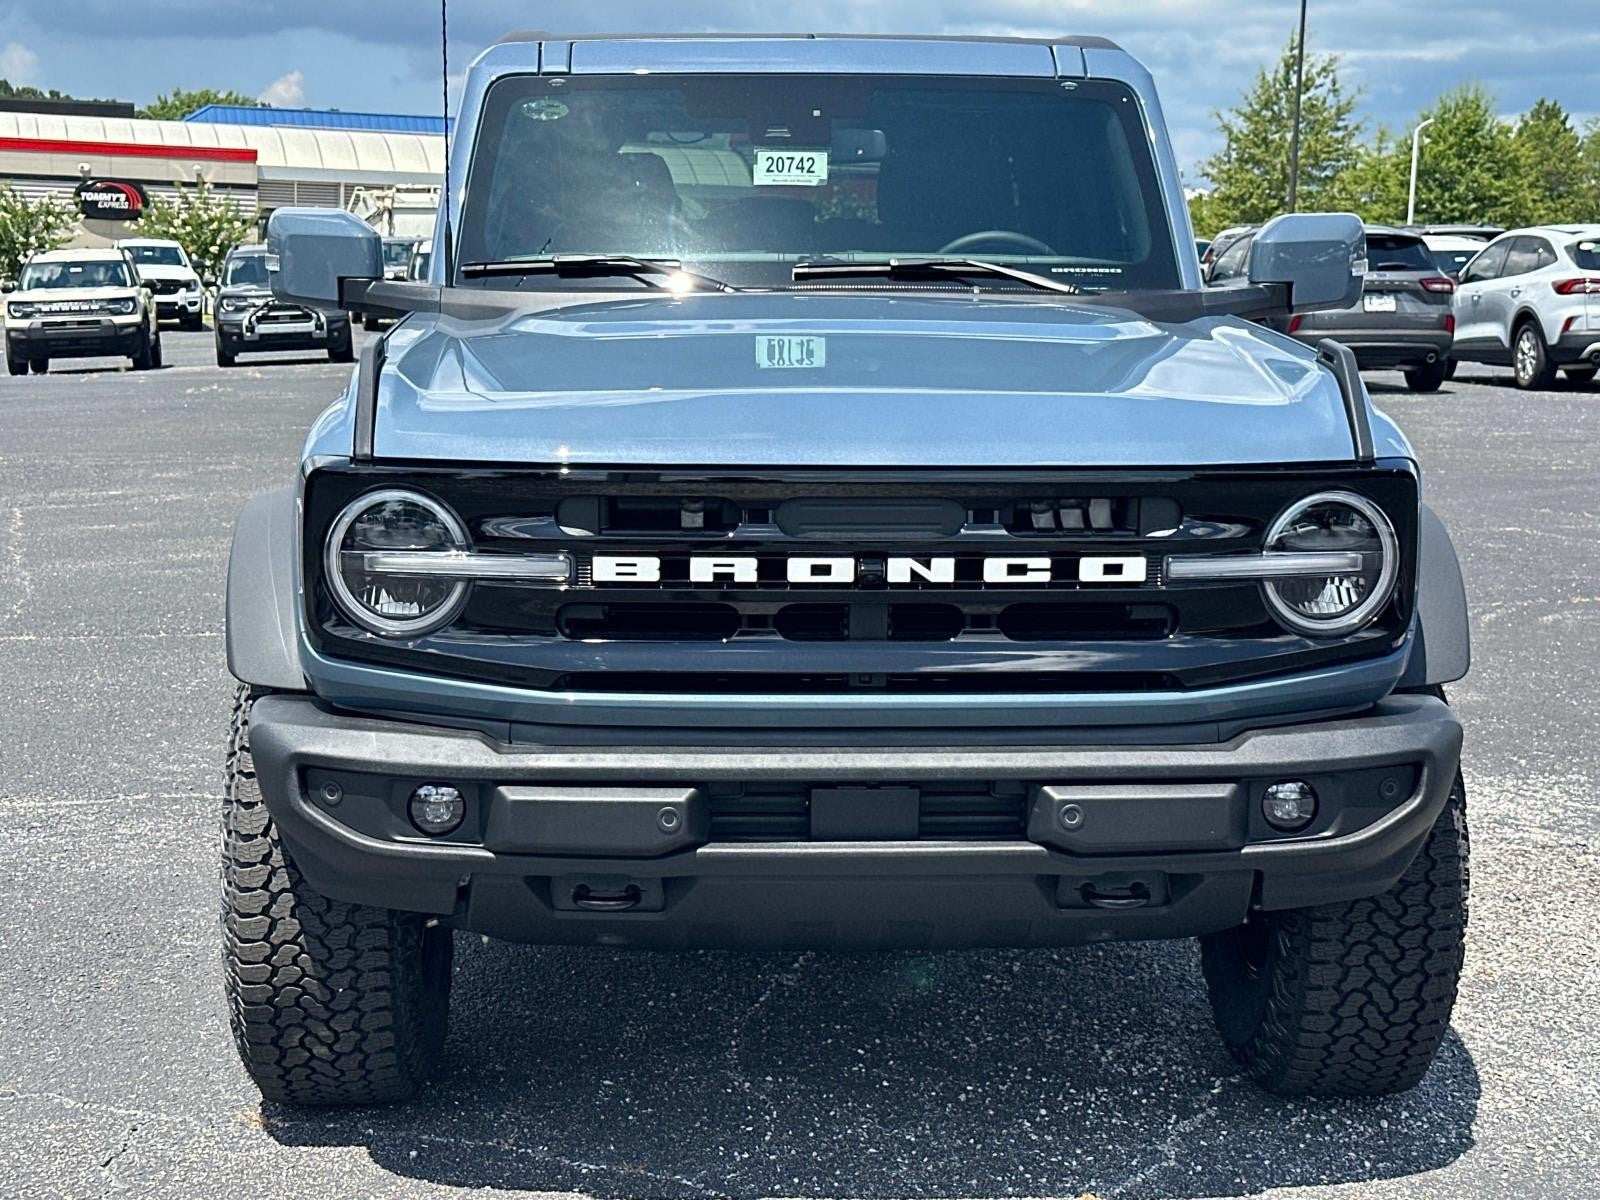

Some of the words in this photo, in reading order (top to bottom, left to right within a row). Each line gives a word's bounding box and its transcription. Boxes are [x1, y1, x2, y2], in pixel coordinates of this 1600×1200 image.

[765, 156, 816, 174] 20742
[80, 192, 126, 201] TOMMY'S
[98, 201, 129, 209] EXPRESS
[592, 556, 1147, 583] BRONCO
